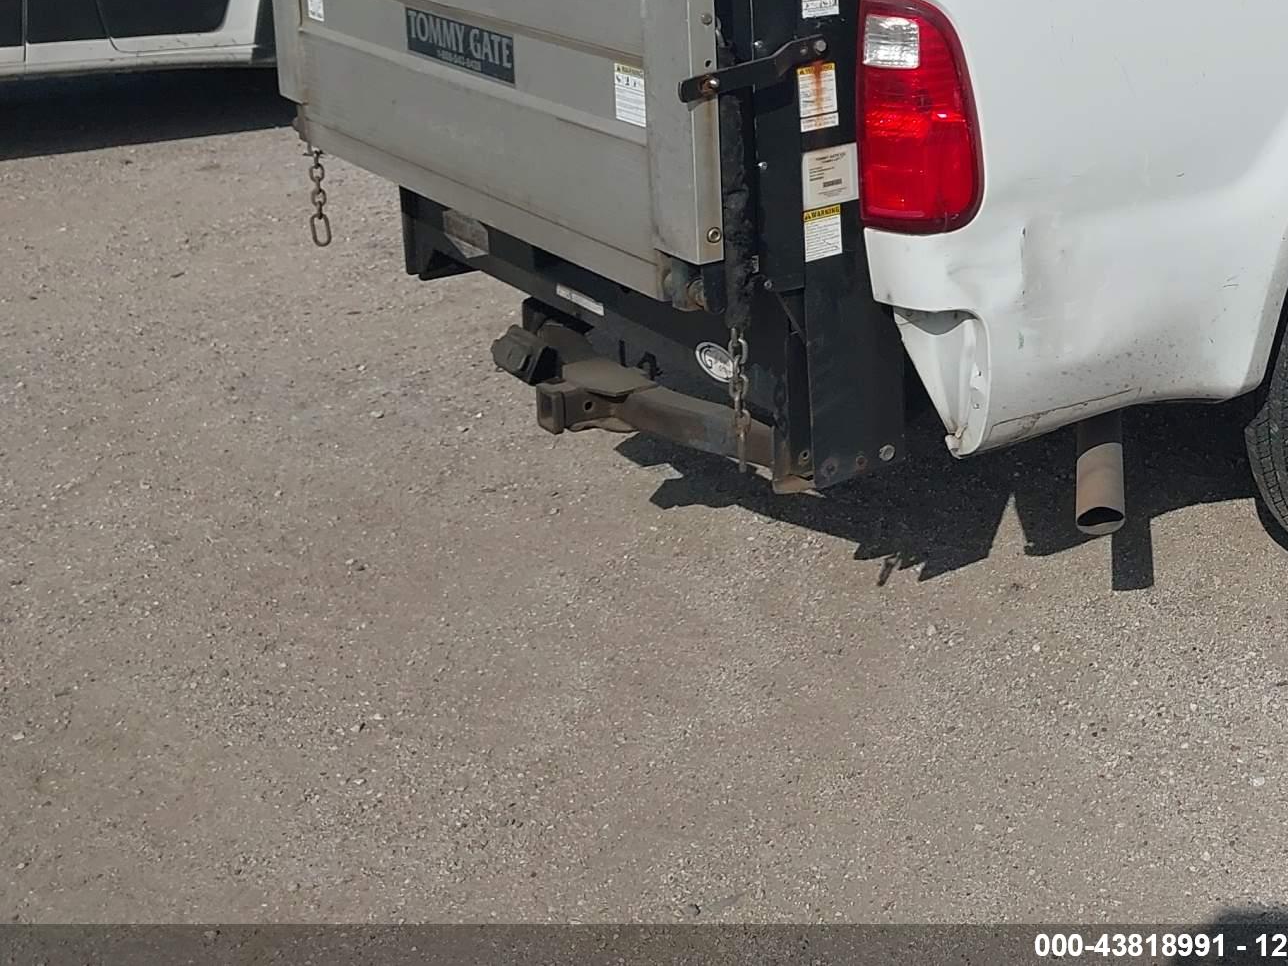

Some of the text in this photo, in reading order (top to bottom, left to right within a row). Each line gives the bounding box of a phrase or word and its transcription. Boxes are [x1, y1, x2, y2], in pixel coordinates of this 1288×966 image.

[407, 10, 465, 53] TOMMY
[469, 28, 513, 69] GATE
[811, 206, 840, 218] WARNING
